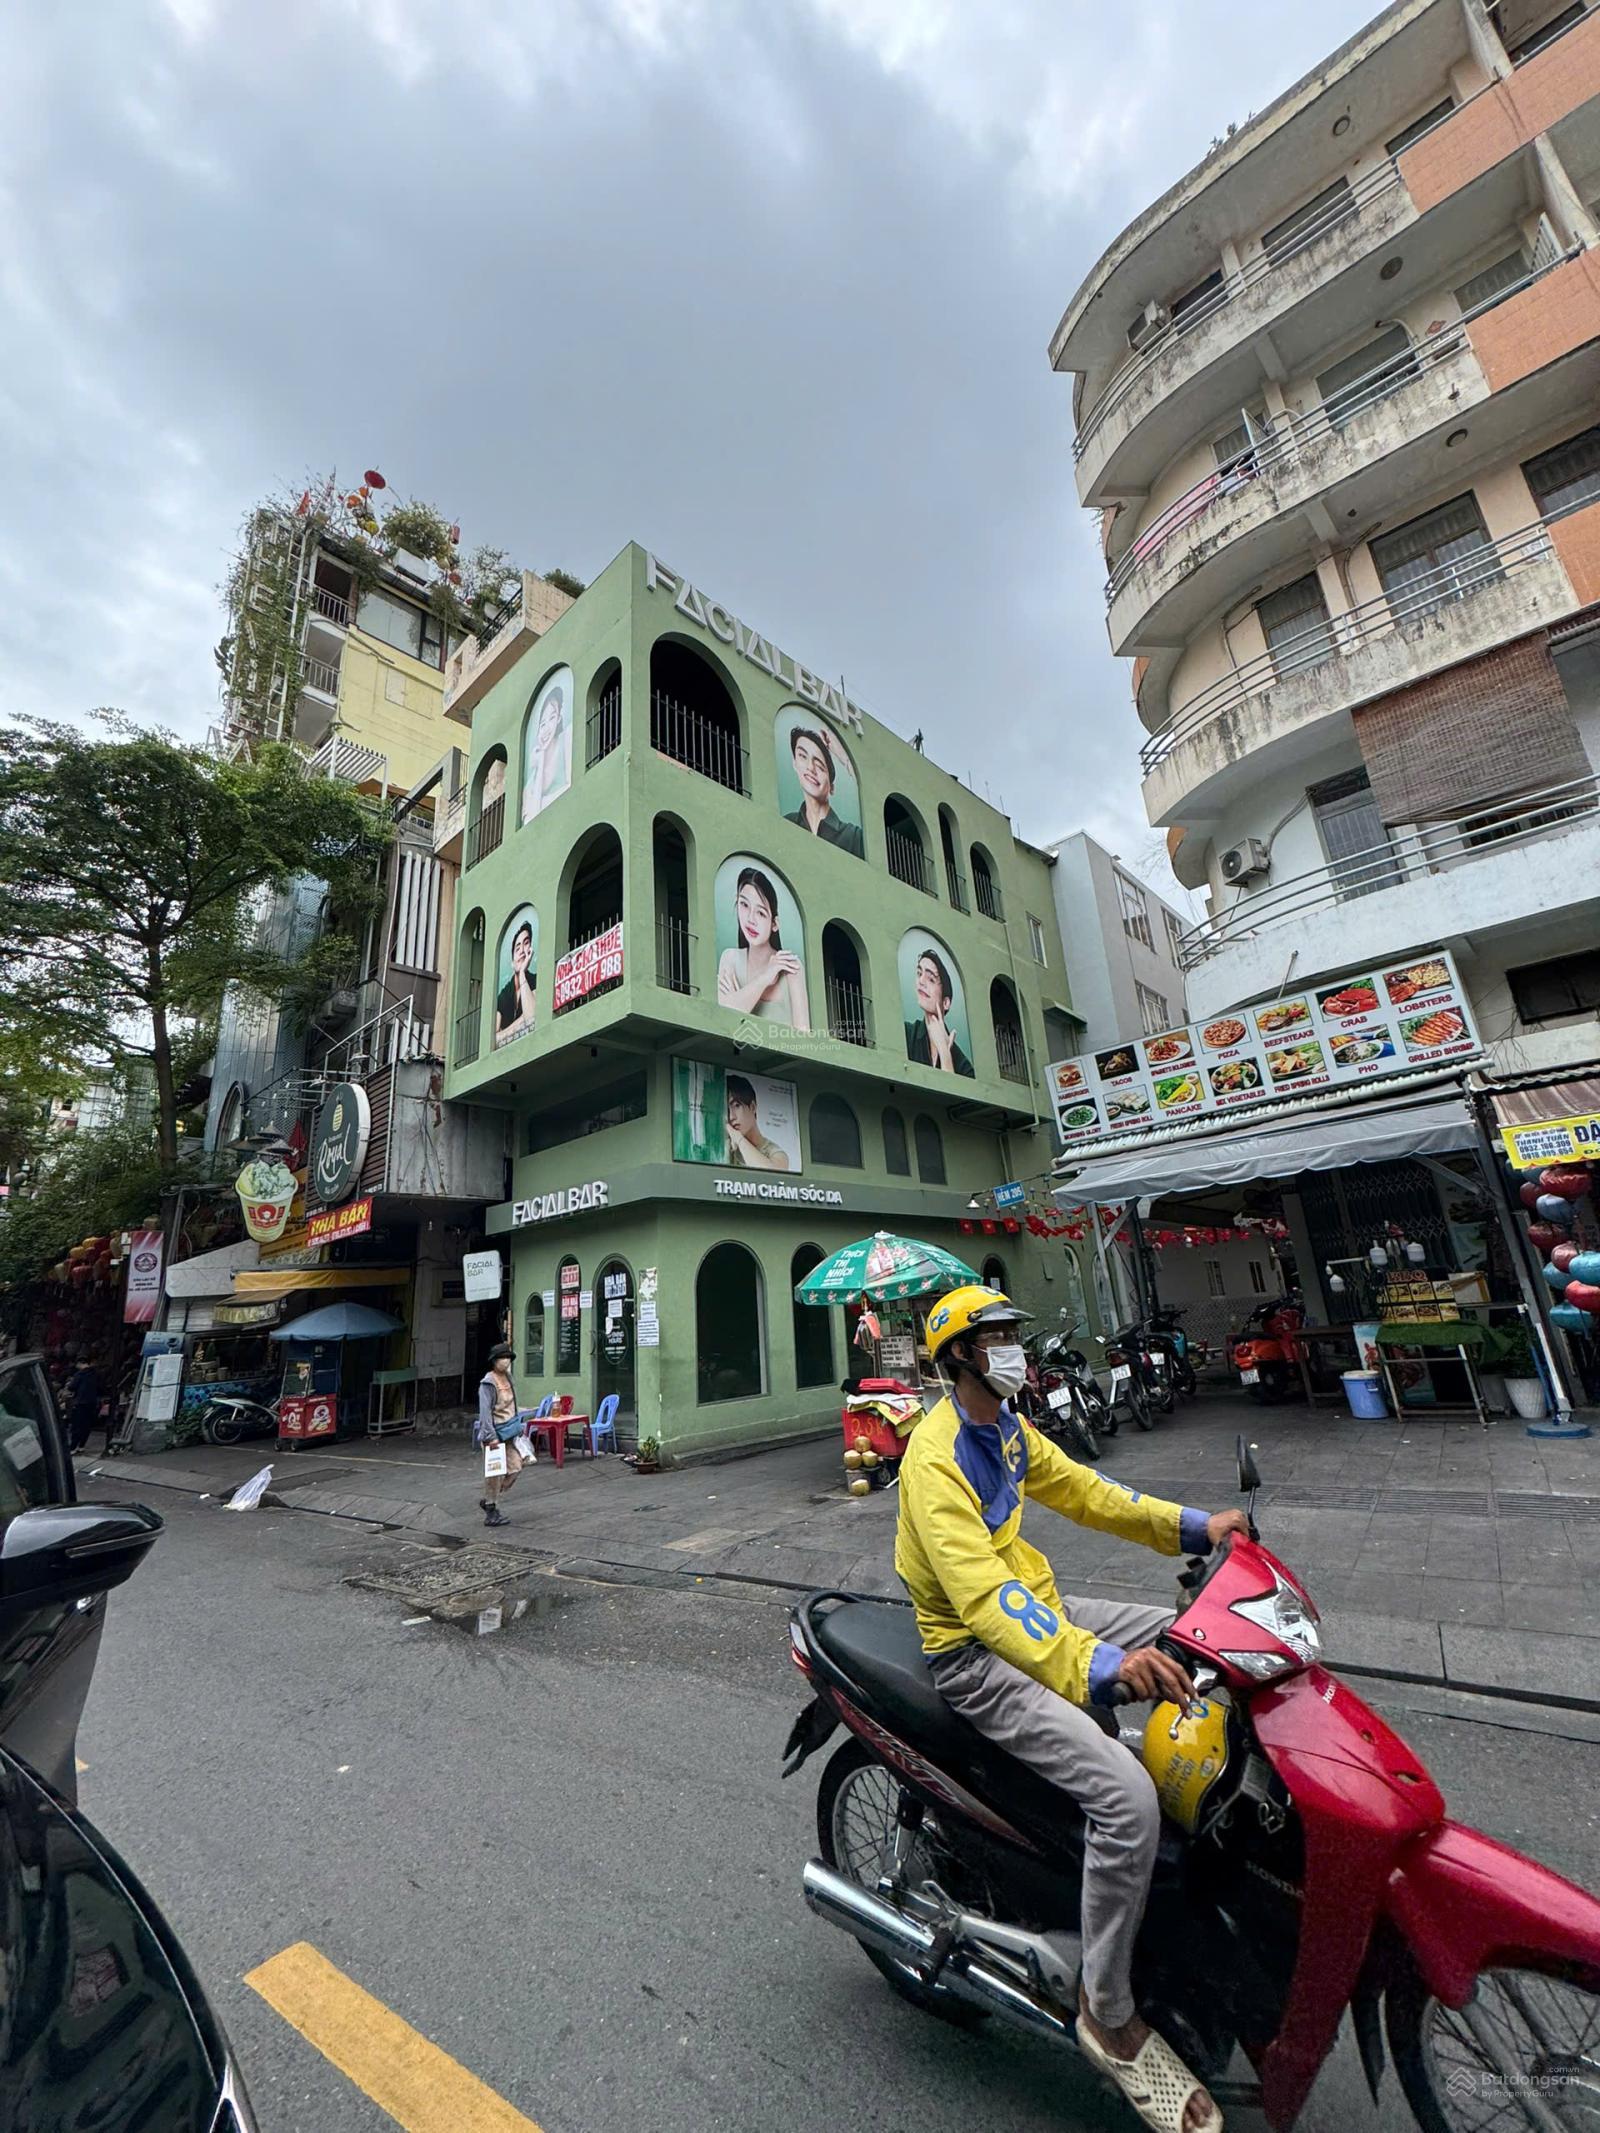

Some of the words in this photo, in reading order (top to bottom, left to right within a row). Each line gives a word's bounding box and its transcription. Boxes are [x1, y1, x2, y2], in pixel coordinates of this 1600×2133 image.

[646, 551, 793, 690] FACIAL
[794, 662, 864, 736] BAR
[600, 952, 622, 978] 988
[1398, 994, 1453, 1014] LOBSTERS
[1340, 1016, 1368, 1028] CRAB
[1264, 1029, 1314, 1048] BEEFSTEAKS
[1217, 1049, 1240, 1060] PIZZA
[1408, 1050, 1442, 1064] GRILLED
[1443, 1042, 1475, 1055] SHRIMP
[1358, 1064, 1379, 1075] PHO
[1110, 1076, 1133, 1087] TACOS
[1274, 1083, 1290, 1094] FRIED
[1228, 1090, 1266, 1103] VEGETABLES
[1165, 1104, 1202, 1117] PANCAKE
[713, 1180, 757, 1199] TRẠM
[799, 1184, 825, 1202] SÓC
[826, 1190, 843, 1203] DA
[511, 1190, 566, 1226] FACIAL
[568, 1181, 608, 1210] BAR
[311, 1212, 336, 1237] NHÀ
[338, 1203, 368, 1227] BÁN
[467, 1260, 495, 1270] FACIAL
[999, 1579, 1060, 1642] be
